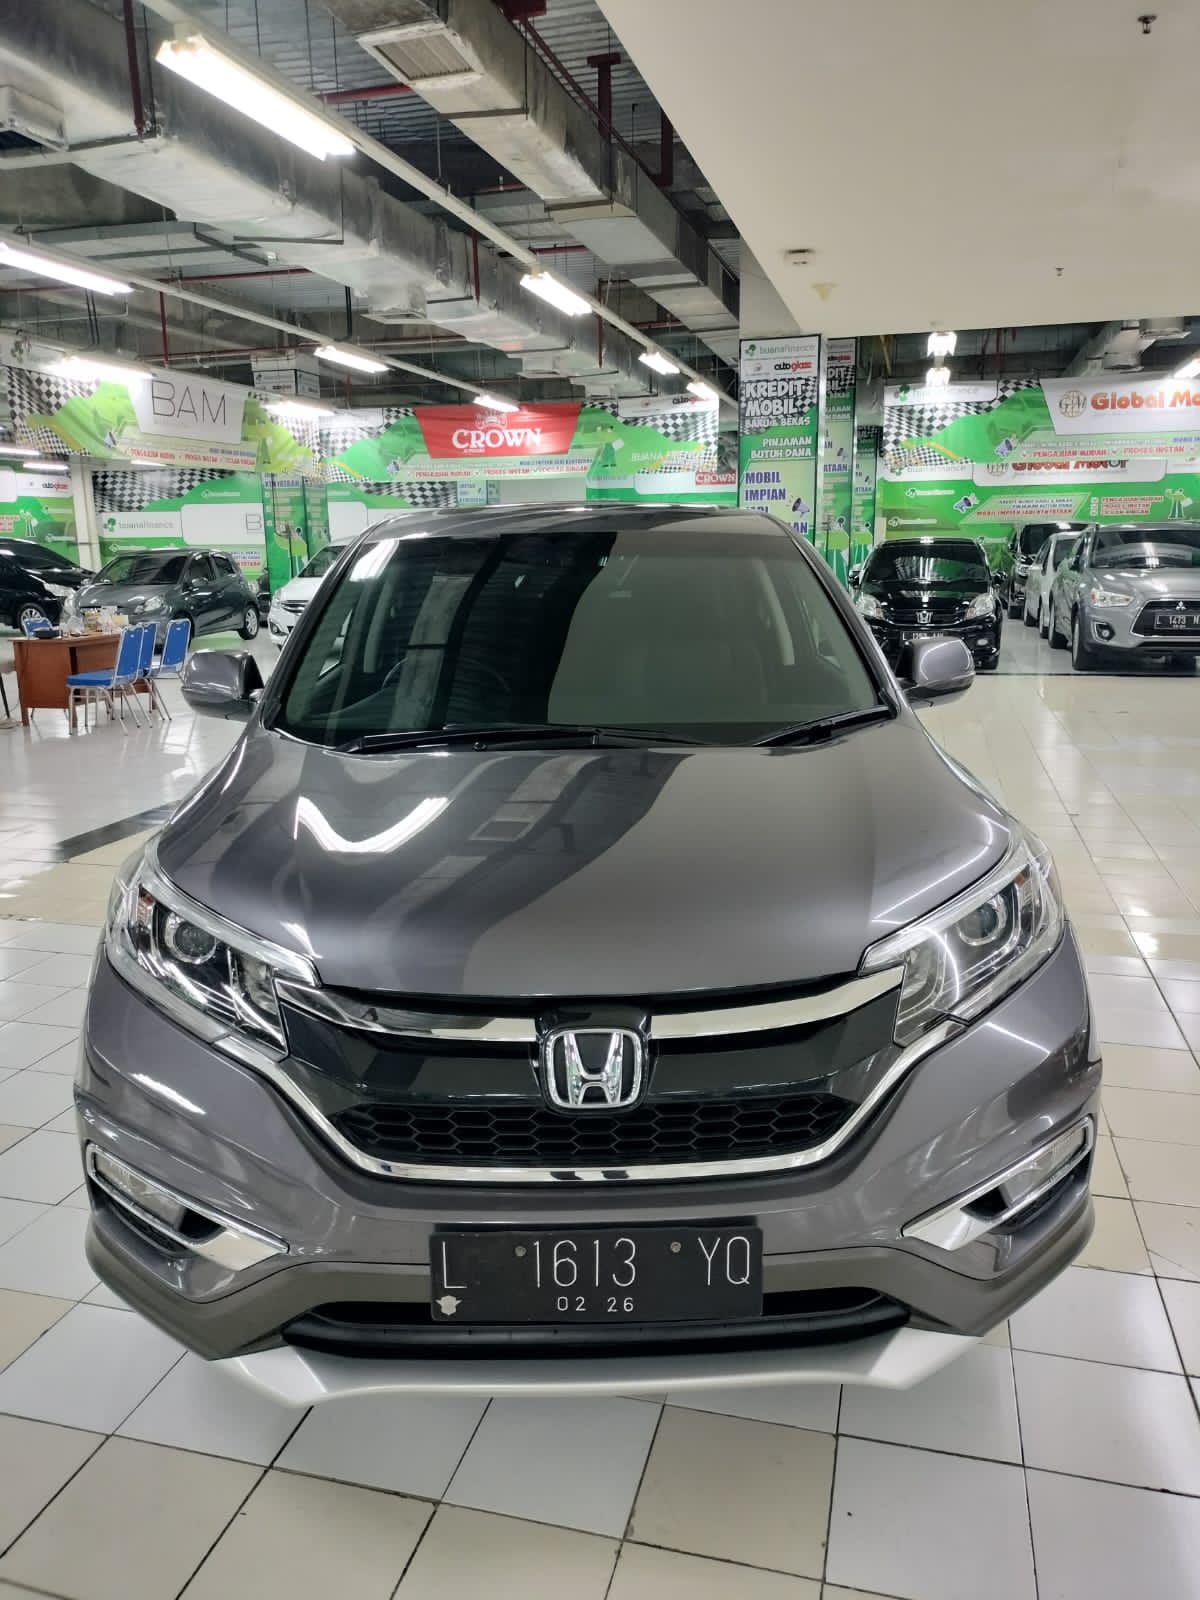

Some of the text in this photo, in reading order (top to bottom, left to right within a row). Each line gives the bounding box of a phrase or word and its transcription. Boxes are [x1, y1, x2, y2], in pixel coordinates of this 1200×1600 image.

[745, 380, 806, 398] KREDIT
[151, 380, 227, 425] BAM
[745, 399, 798, 417] MOBIL
[1091, 391, 1165, 411] Global
[782, 416, 811, 427] BEKAS
[452, 427, 541, 450] CROWN
[762, 436, 812, 447] PINJAMAN
[750, 447, 812, 459] BUTUH DANA
[696, 472, 736, 484] CROWN
[745, 471, 782, 484] MOBIL
[745, 488, 786, 501] IMPIAN
[442, 1236, 751, 1289] L 1613 YQ
[556, 1296, 635, 1312] 02 26
